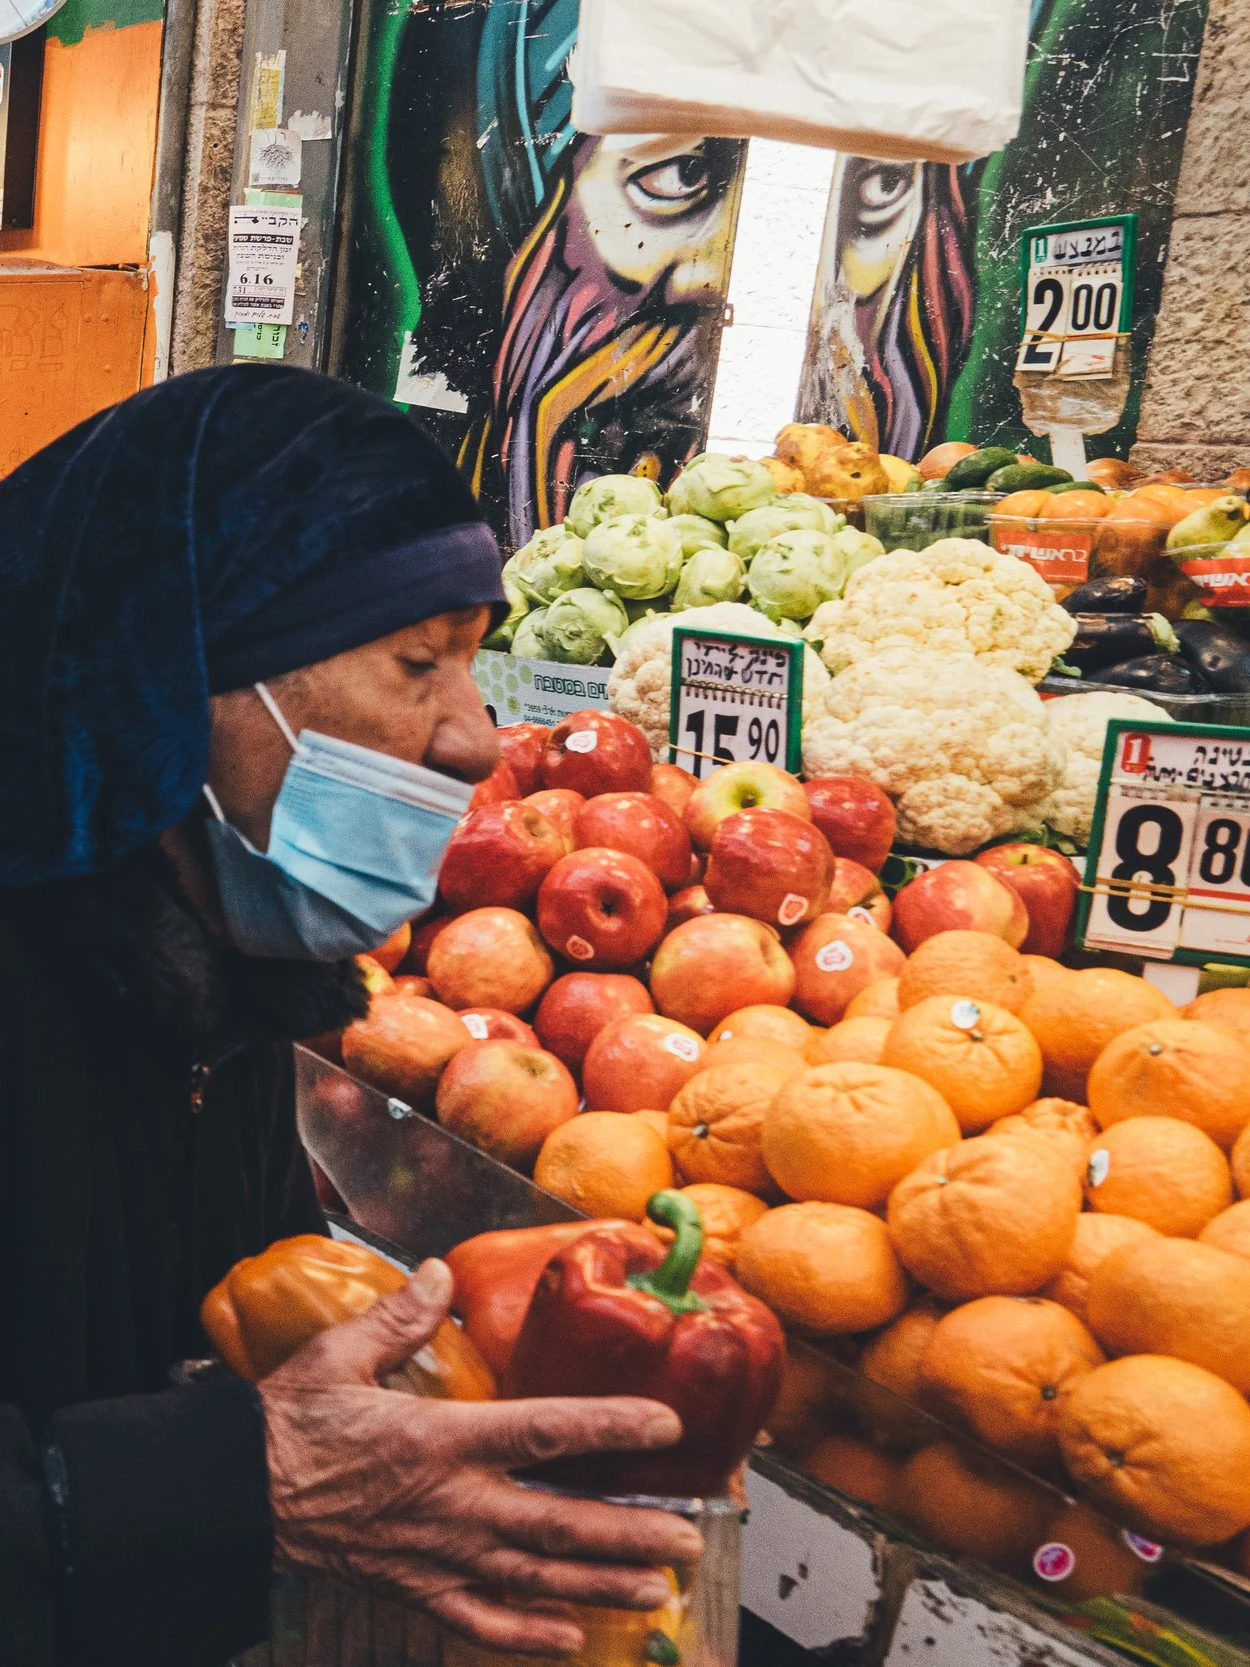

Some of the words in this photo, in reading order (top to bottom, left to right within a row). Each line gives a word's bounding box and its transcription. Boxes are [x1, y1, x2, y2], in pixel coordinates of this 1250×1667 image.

[240, 272, 274, 285] 6.16
[1023, 278, 1064, 364] 2
[1071, 282, 1117, 331] 00
[534, 674, 586, 697] במטבח
[685, 709, 740, 780] 15
[748, 717, 780, 763] 90
[1107, 804, 1184, 932] 8
[1200, 818, 1250, 888] 8
